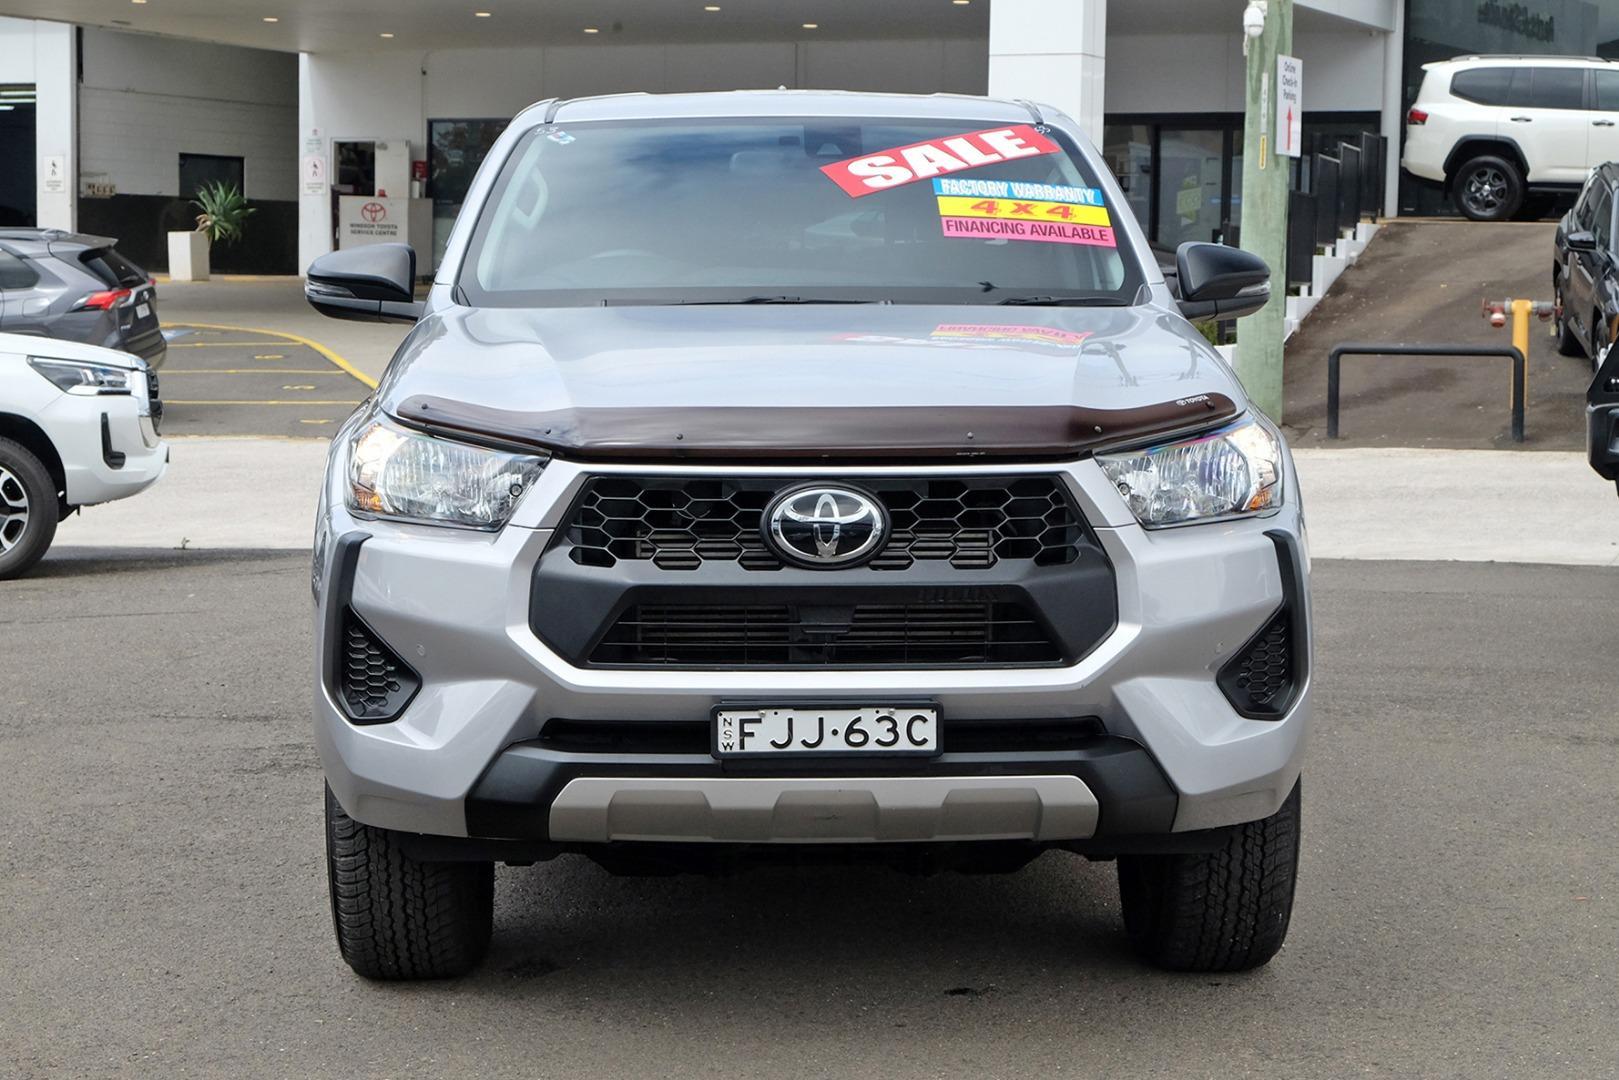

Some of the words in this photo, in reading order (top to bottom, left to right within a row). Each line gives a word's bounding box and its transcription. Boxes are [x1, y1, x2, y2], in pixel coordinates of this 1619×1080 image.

[847, 129, 1041, 188] SALE
[940, 178, 1008, 197] FACTORY
[1011, 183, 1095, 204] WARRANTY
[946, 220, 1025, 235] FINANCING
[1030, 224, 1109, 242] AVAILABLE
